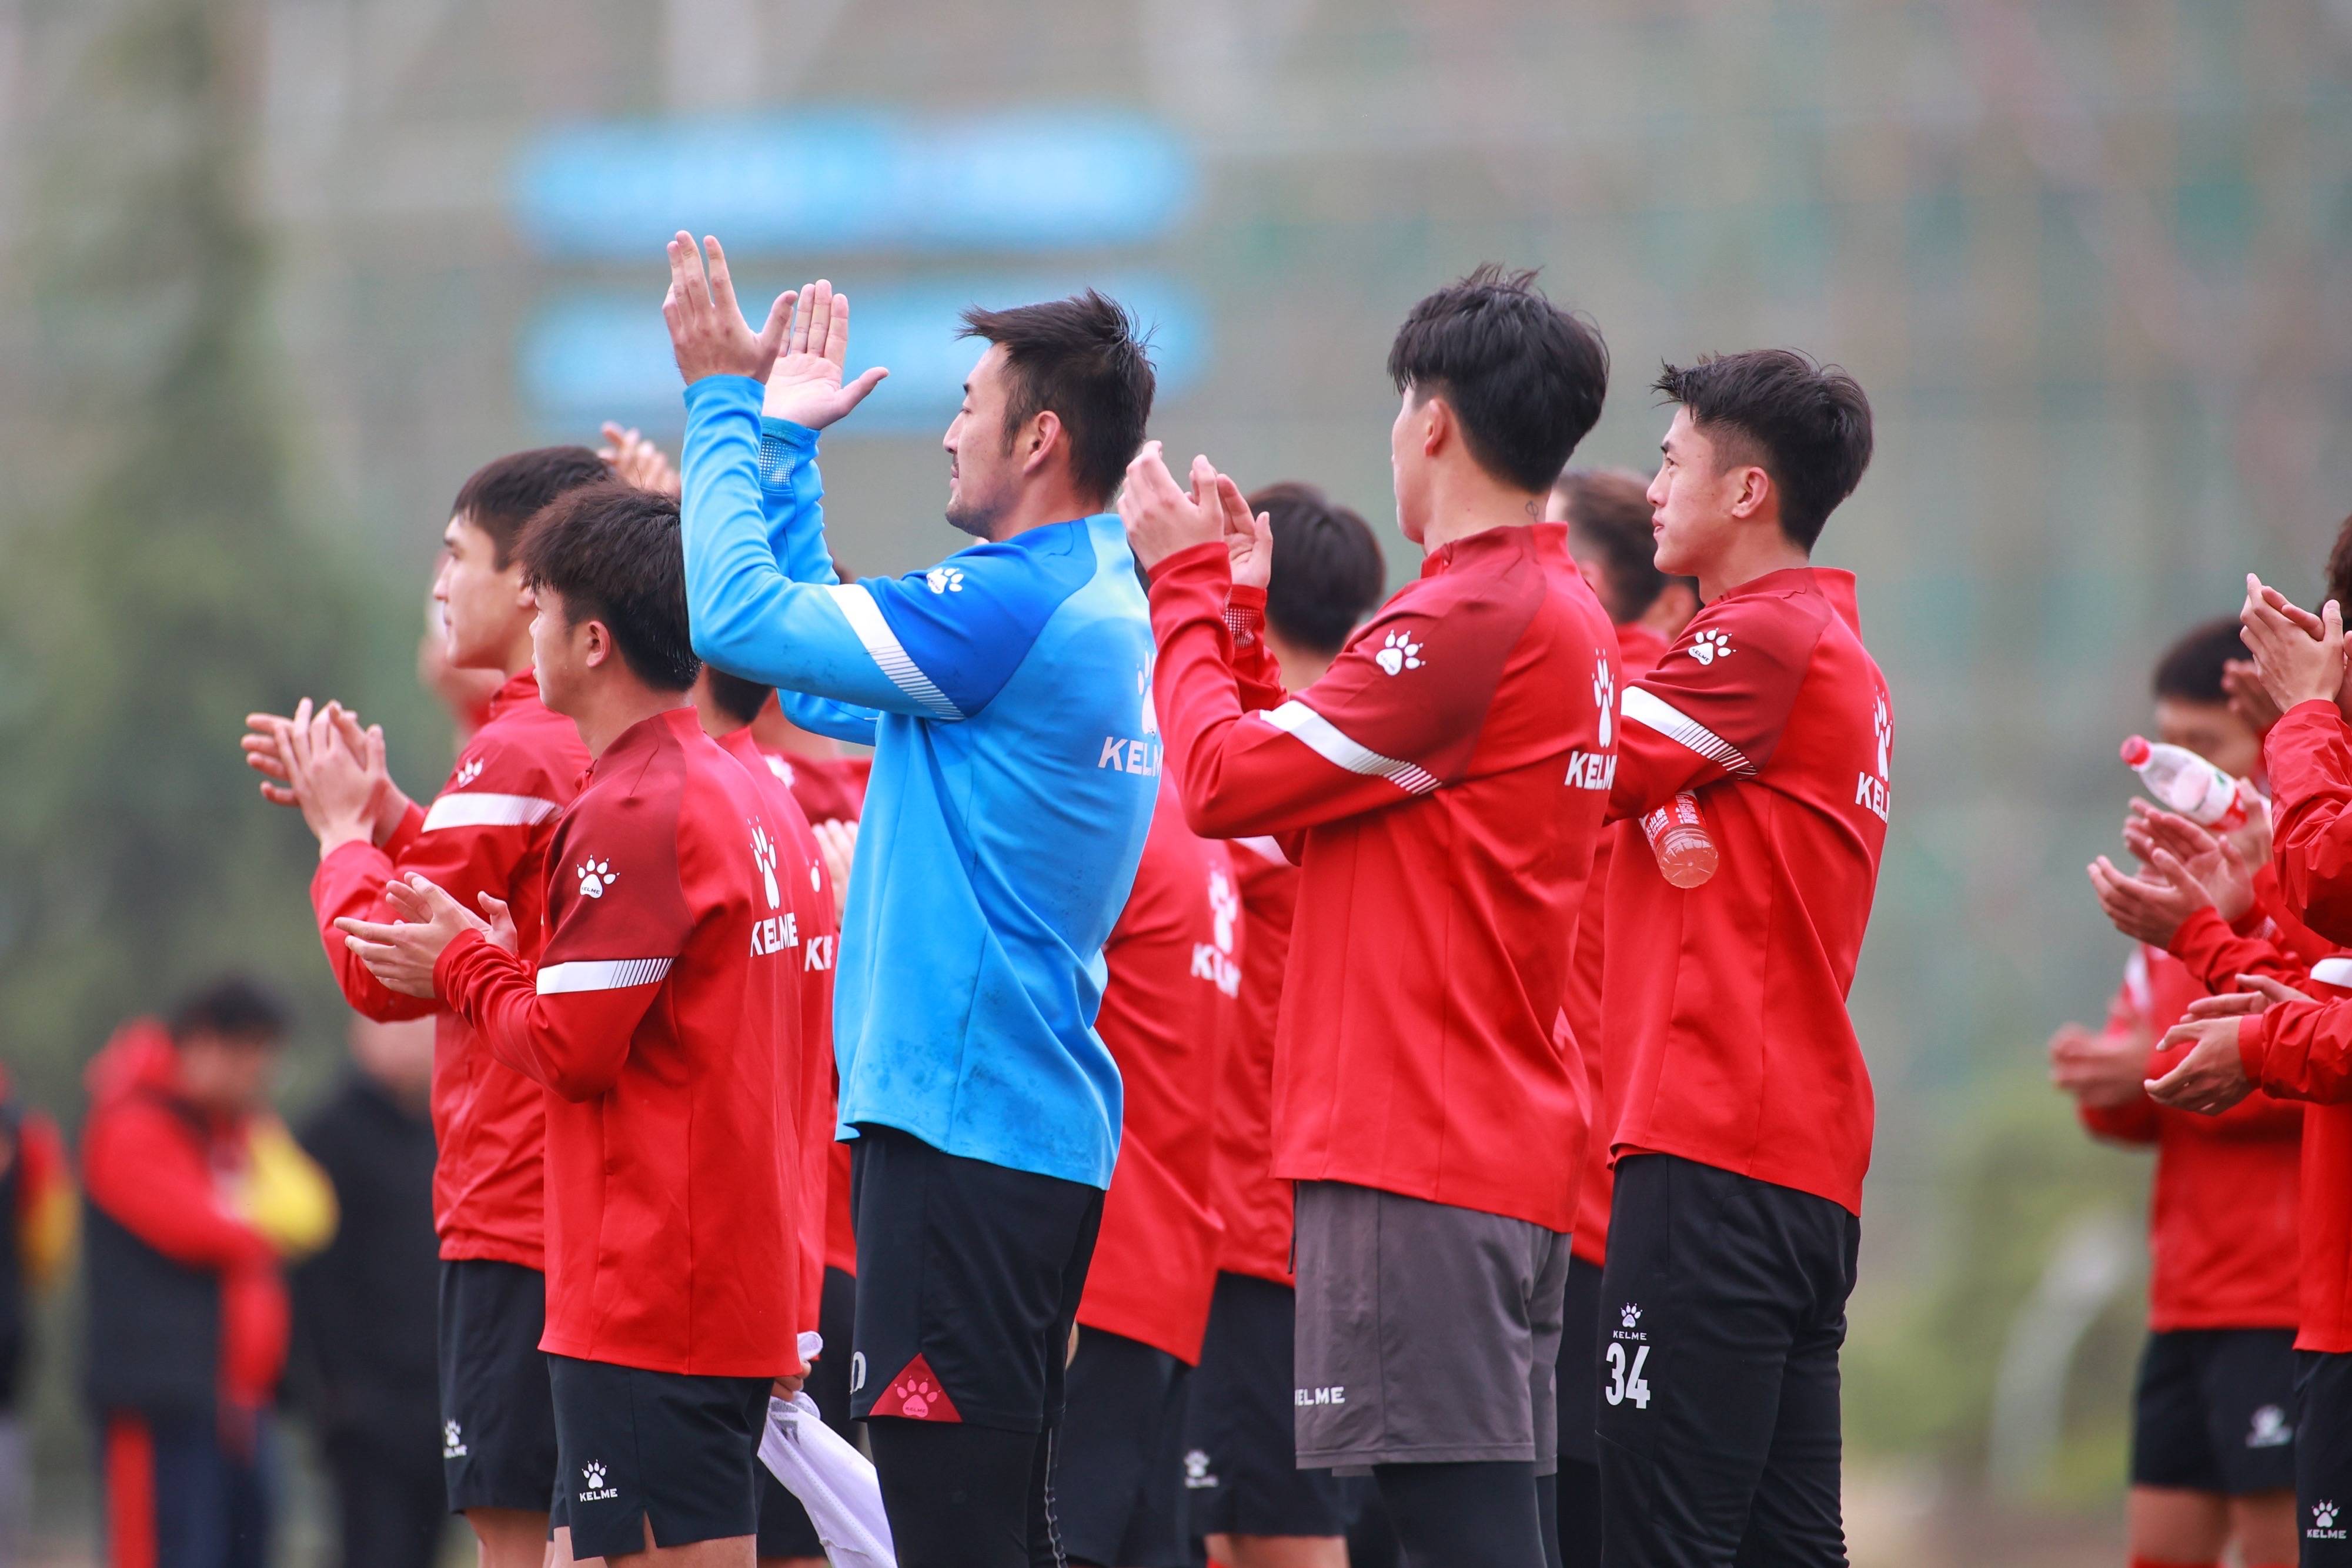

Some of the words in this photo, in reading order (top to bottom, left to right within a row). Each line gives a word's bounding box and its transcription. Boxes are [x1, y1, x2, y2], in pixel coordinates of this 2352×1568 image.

[1564, 750, 1618, 790] KELM
[750, 912, 799, 958] KELME
[1613, 1330, 1647, 1340] KELME
[1605, 1342, 1651, 1409] 34
[579, 1488, 619, 1502] KELME
[2307, 1529, 2347, 1539] KELME
